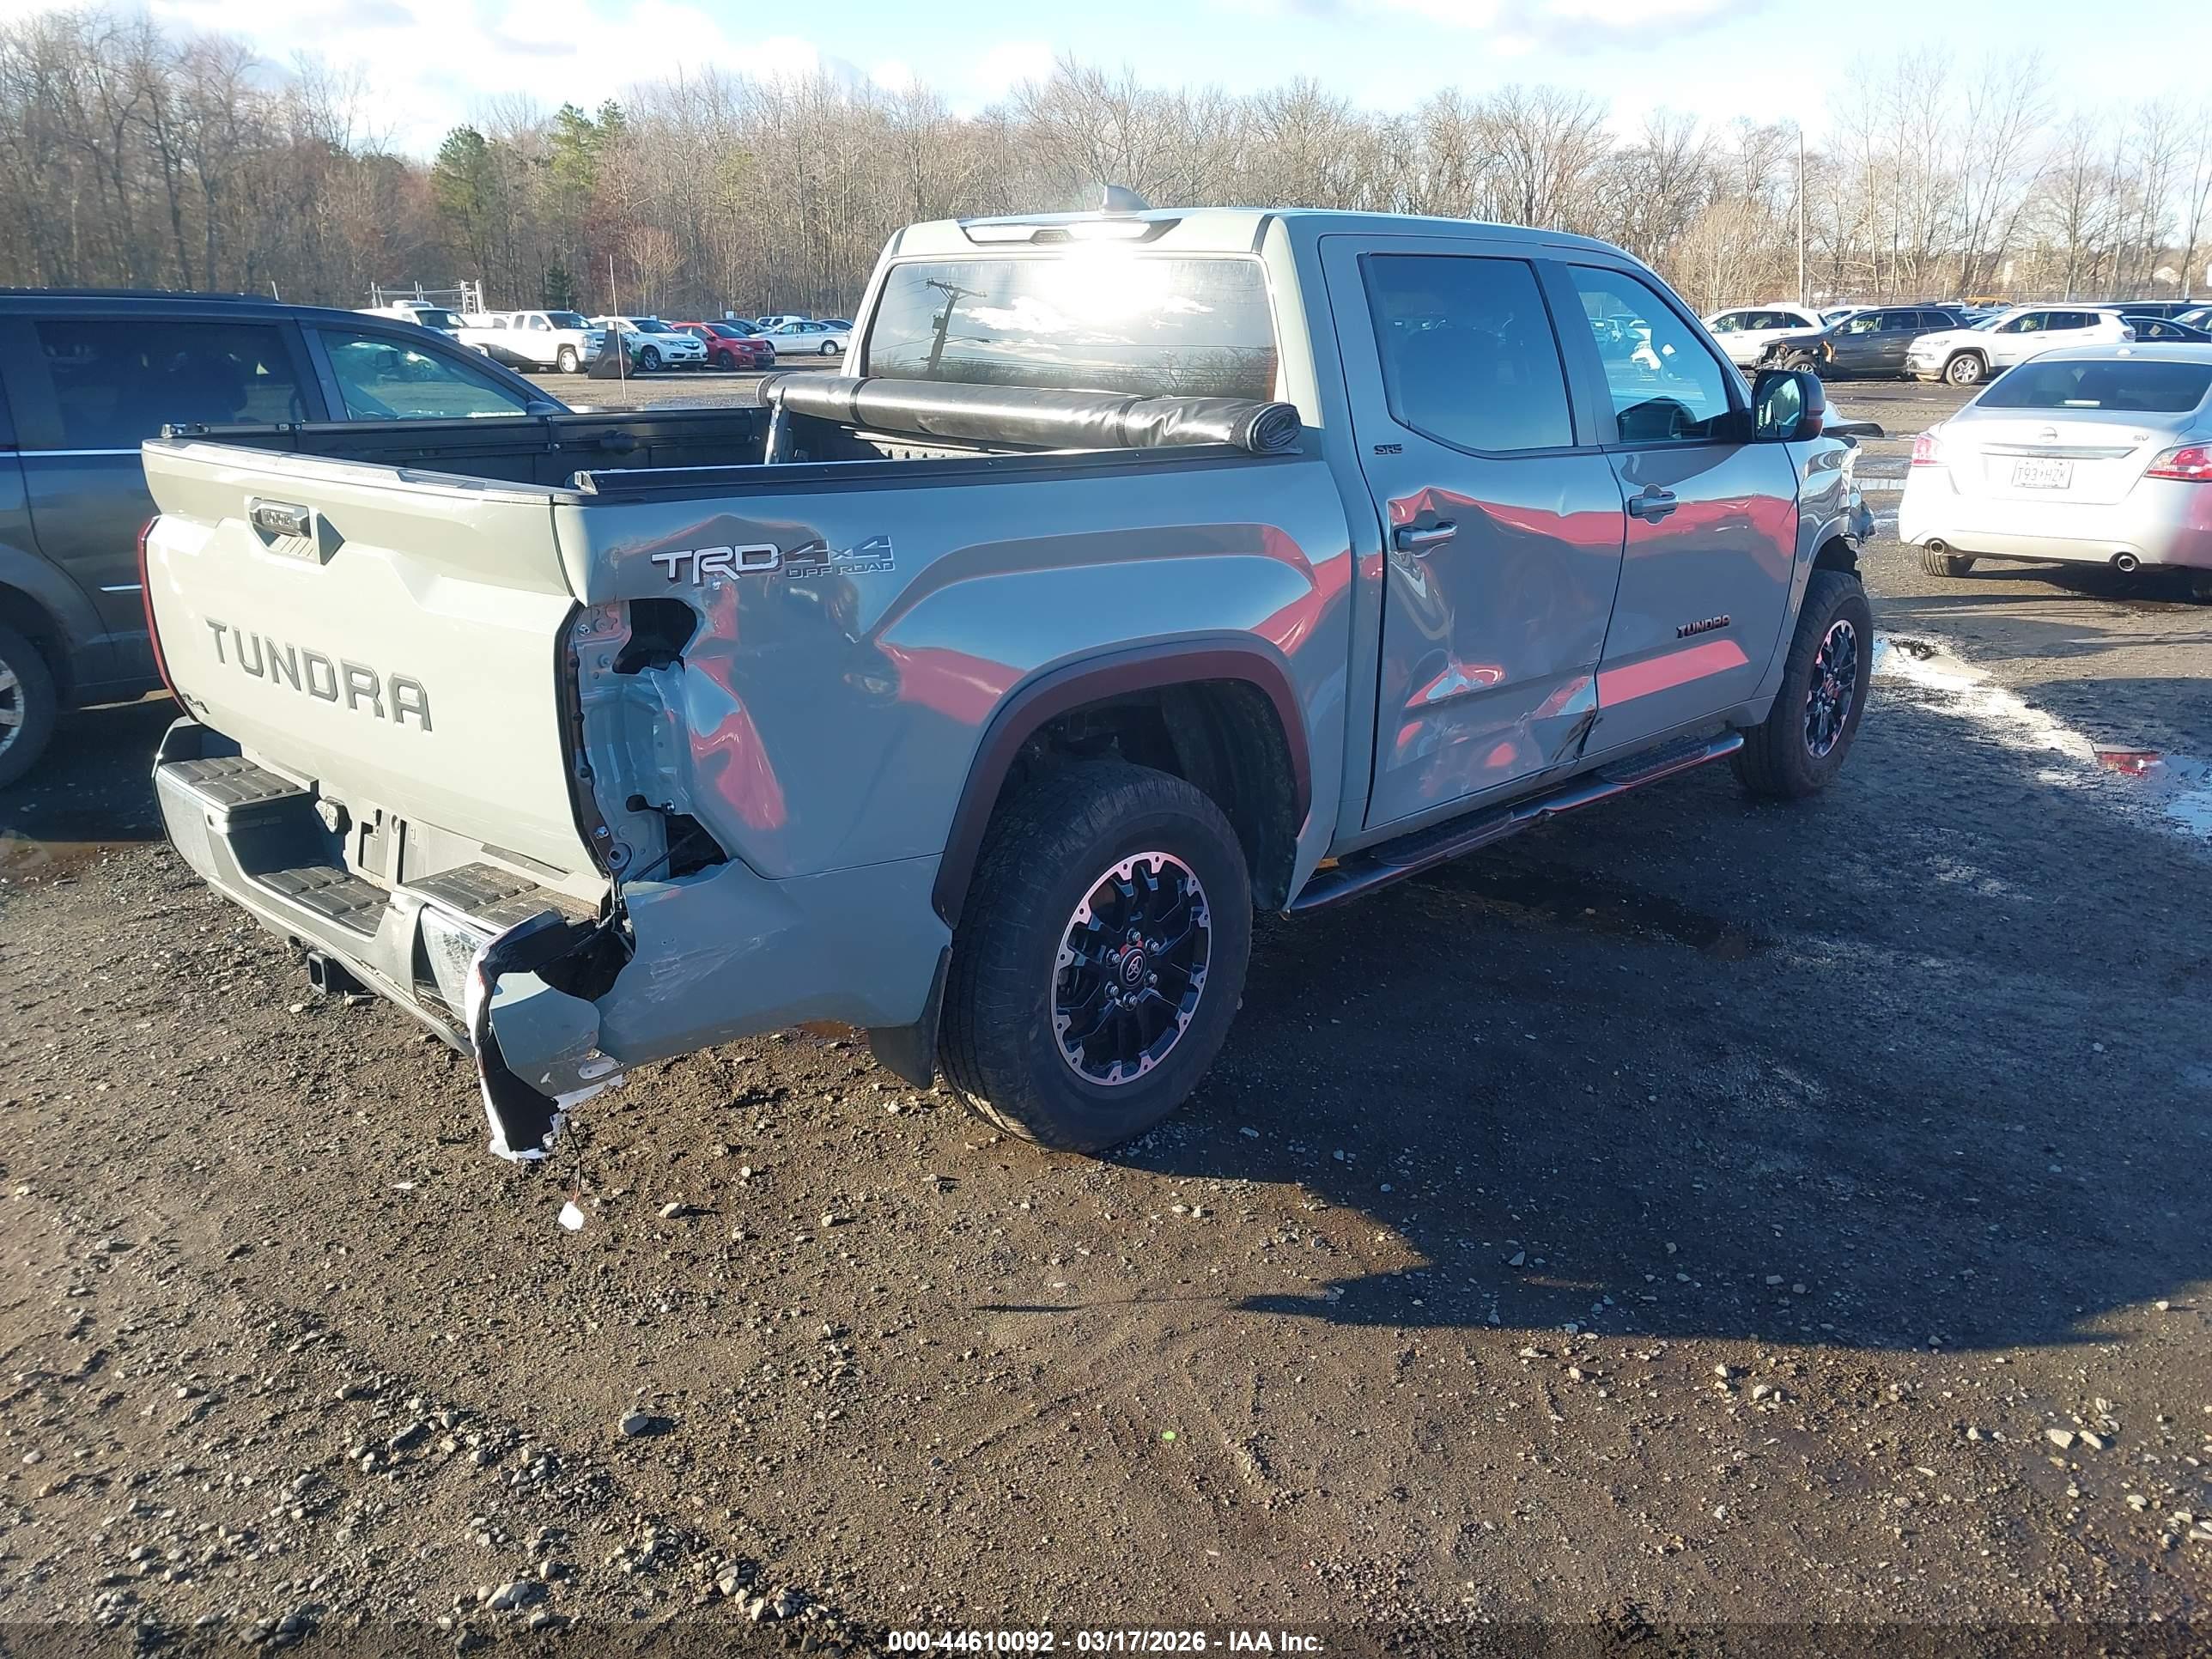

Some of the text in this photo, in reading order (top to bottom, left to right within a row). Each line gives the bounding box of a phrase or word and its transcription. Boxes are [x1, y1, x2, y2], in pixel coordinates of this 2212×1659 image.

[651, 543, 783, 586] TRD
[785, 562, 896, 580] OFF ROAD
[1675, 613, 1731, 640] TUNDRA
[203, 617, 433, 733] TUNDRA
